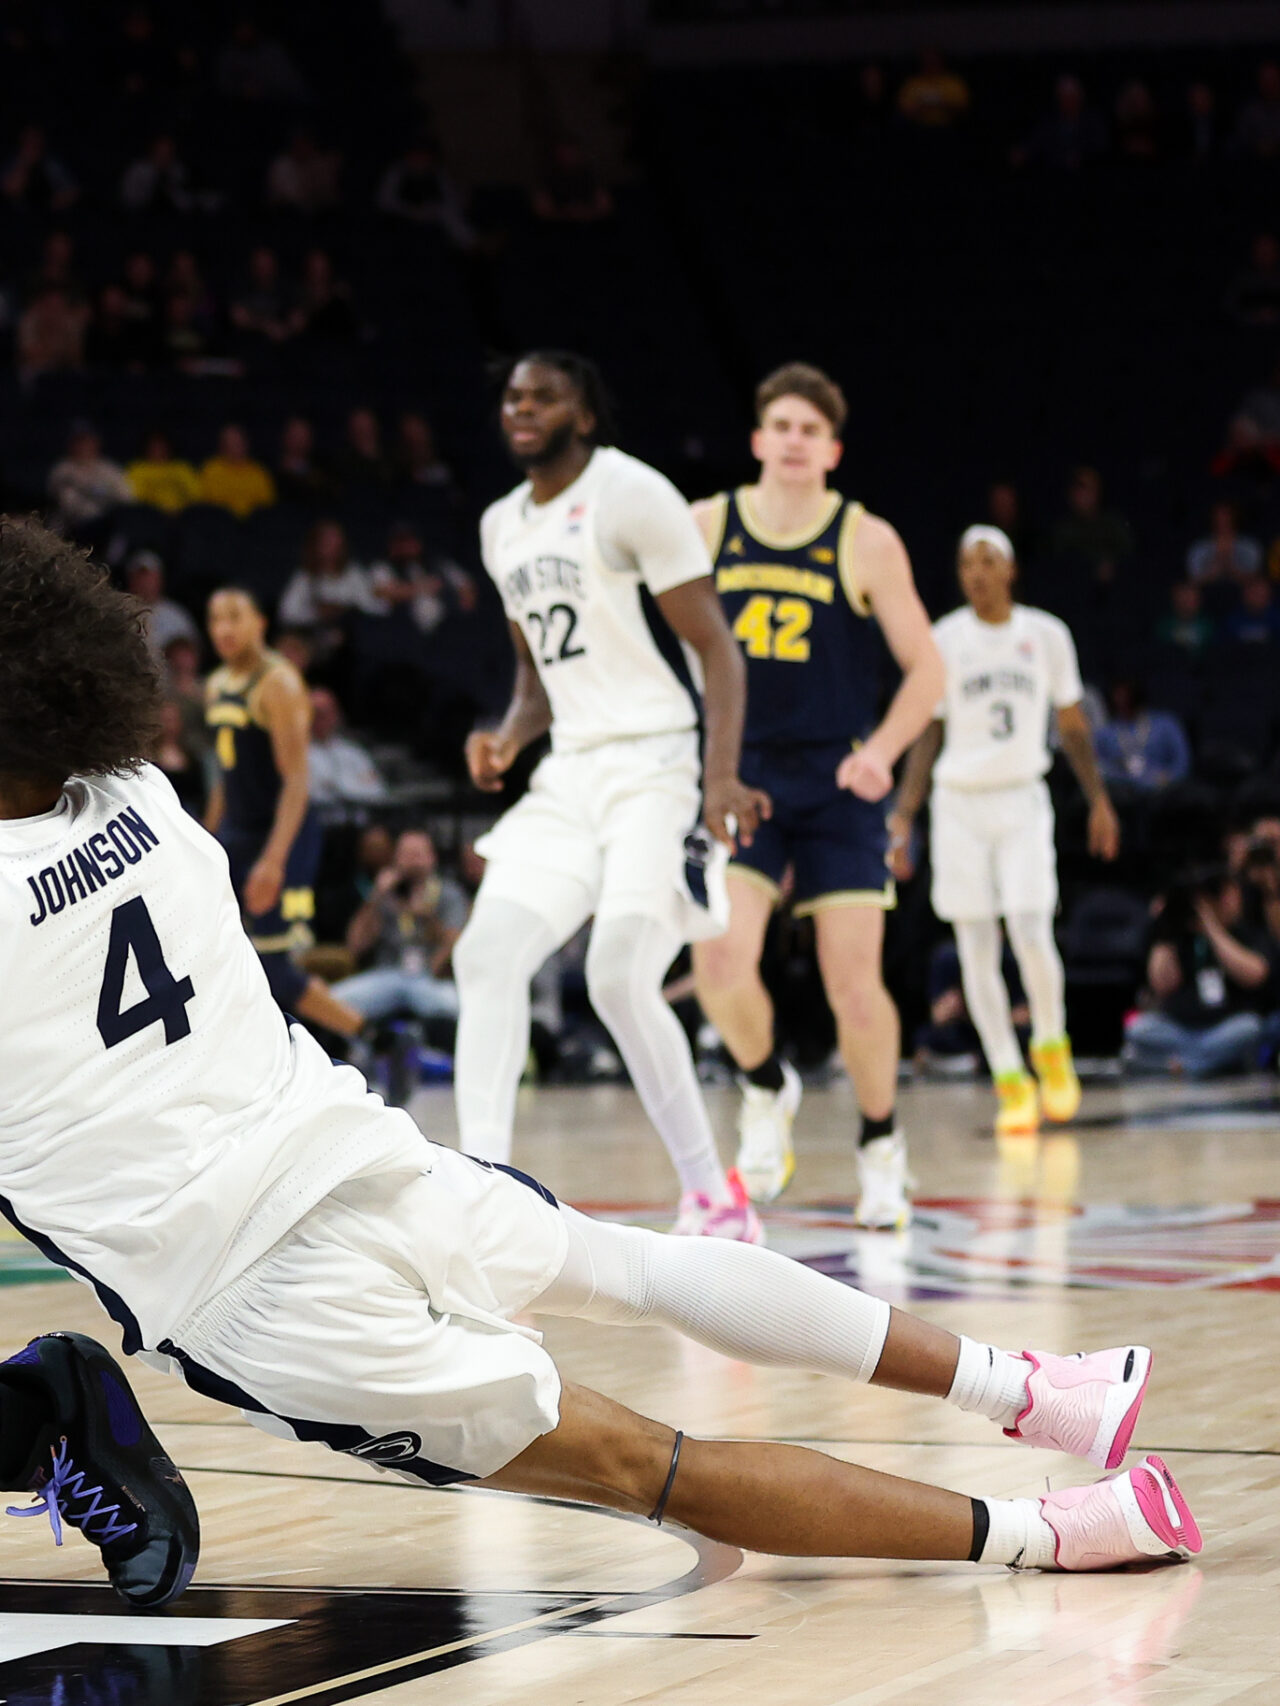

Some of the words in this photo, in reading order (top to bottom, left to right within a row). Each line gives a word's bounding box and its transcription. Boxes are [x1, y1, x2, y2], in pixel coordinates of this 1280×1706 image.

[528, 603, 587, 667] 22
[733, 593, 813, 664] 42
[989, 700, 1014, 741] 3
[26, 806, 161, 927] JOHNSON
[96, 895, 196, 1049] 4
